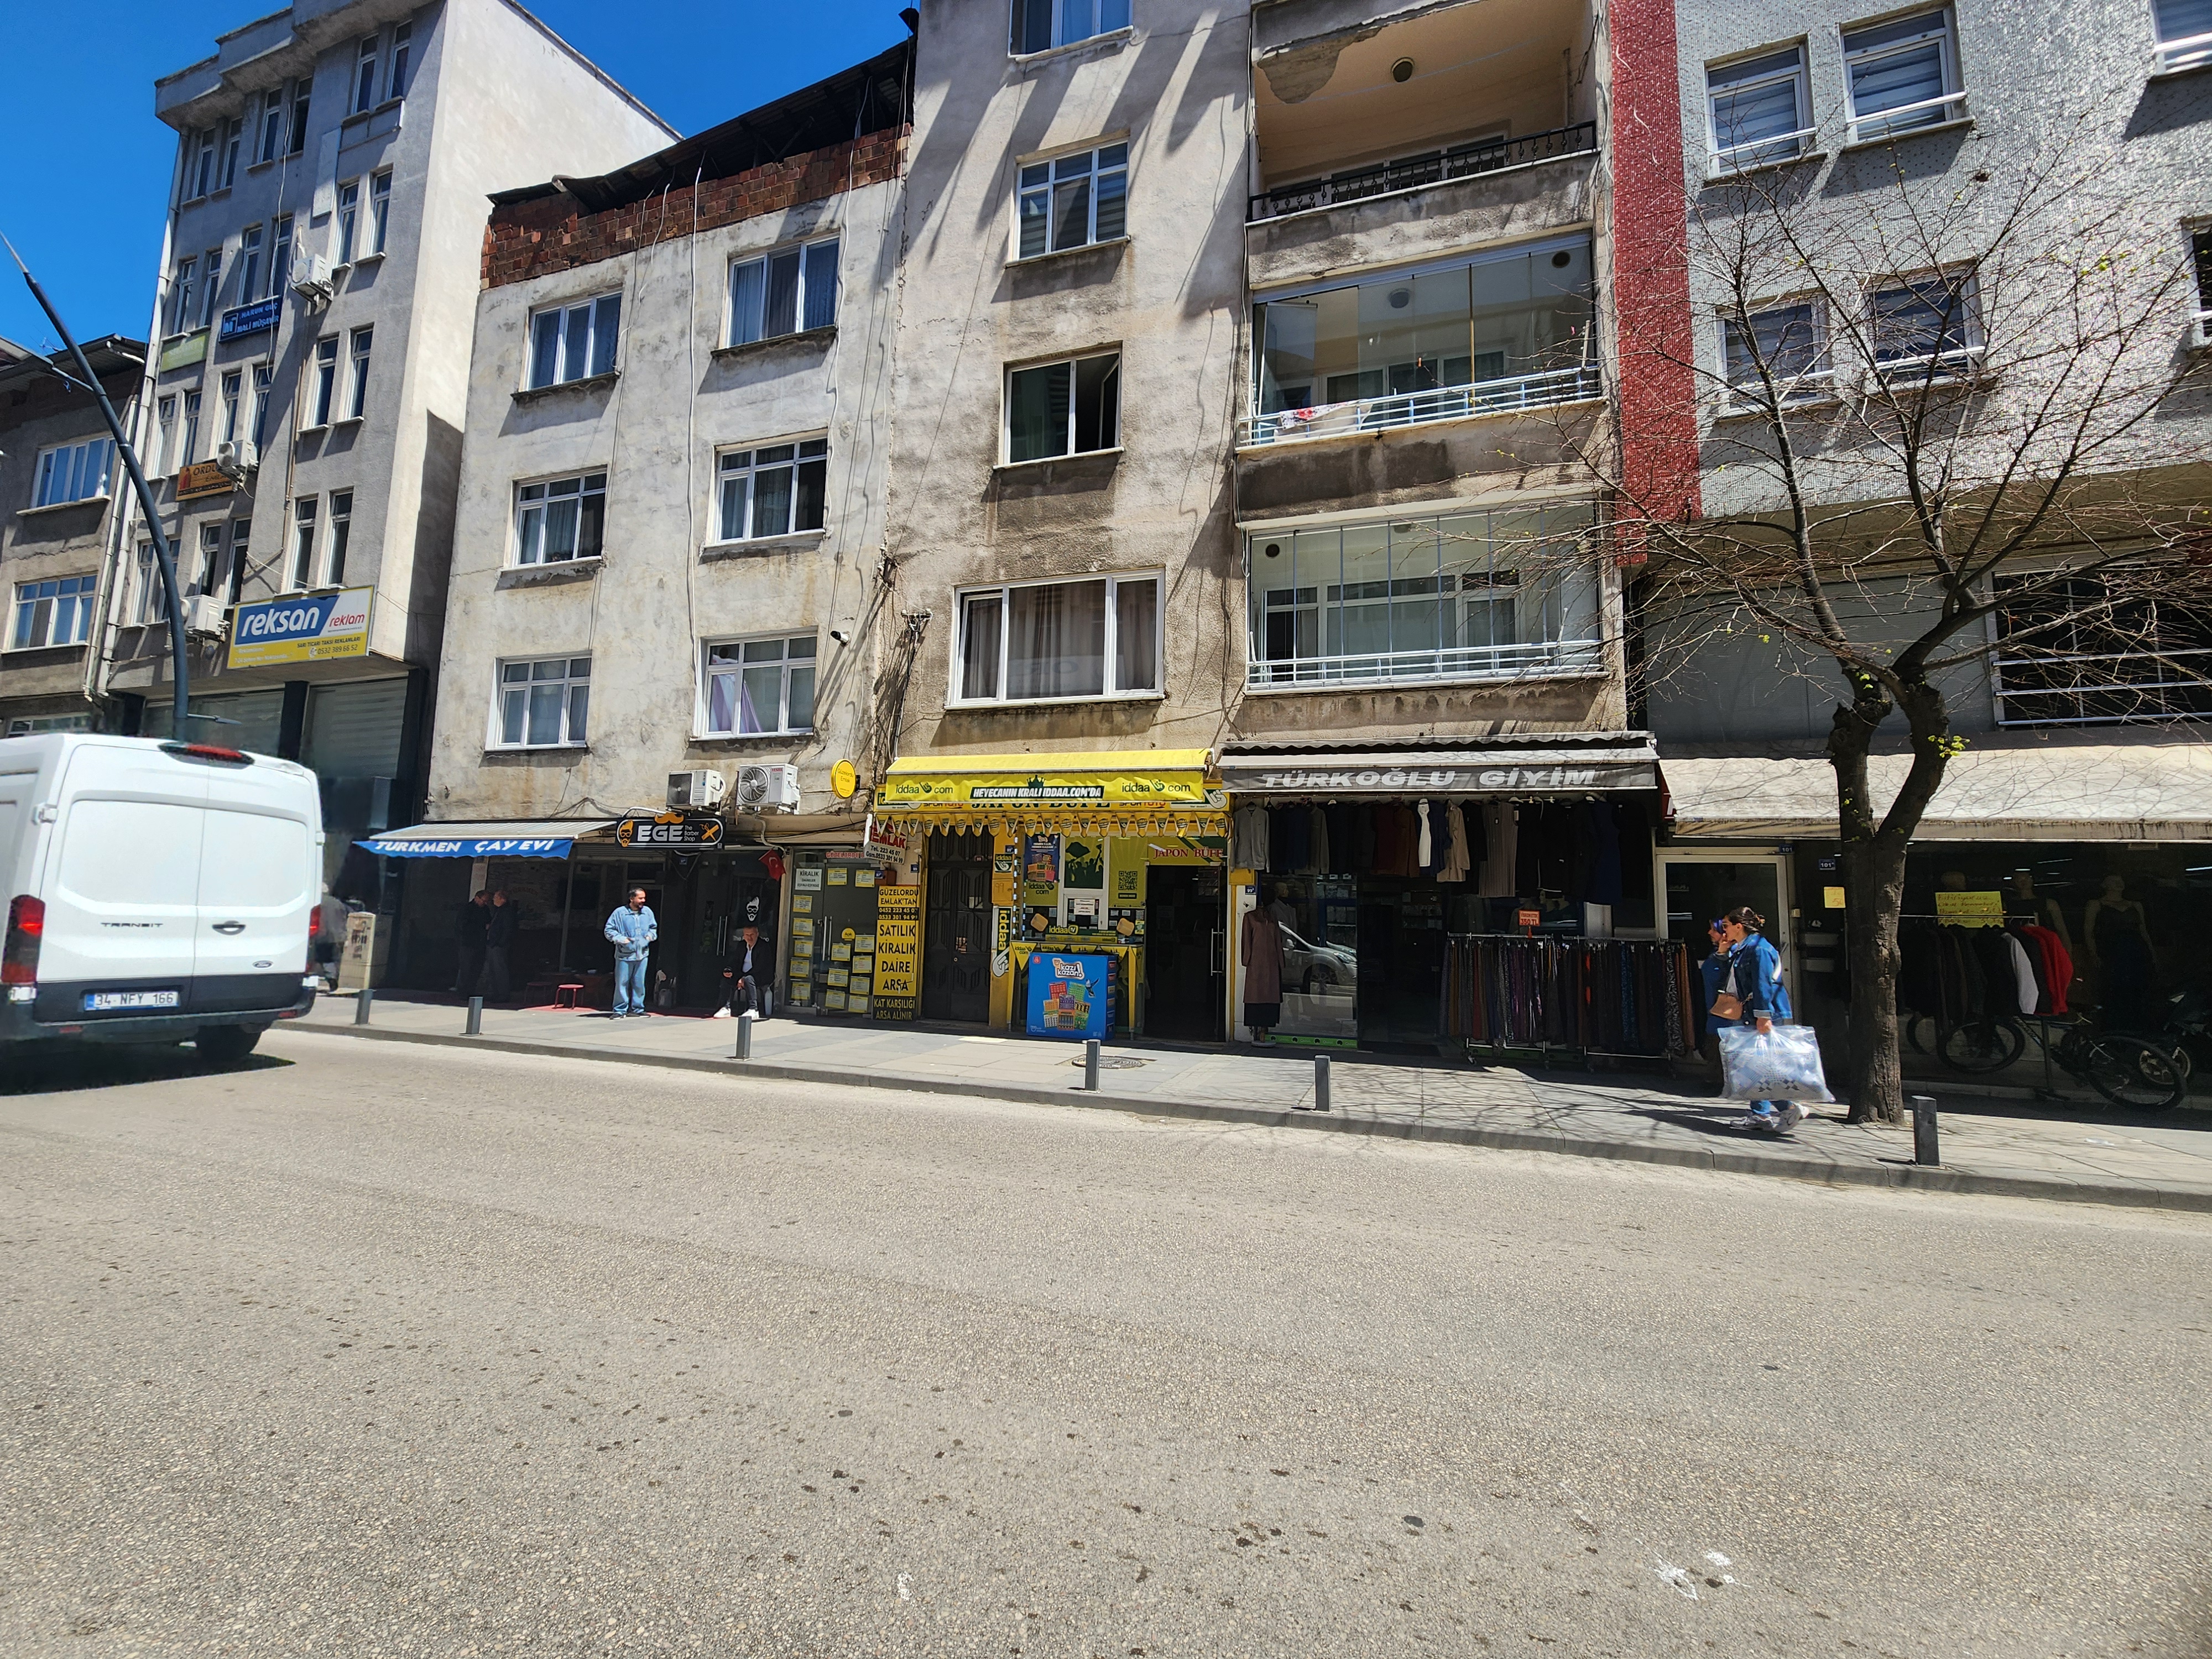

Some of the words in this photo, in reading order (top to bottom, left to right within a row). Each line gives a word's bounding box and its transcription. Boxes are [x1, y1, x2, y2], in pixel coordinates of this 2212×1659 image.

[241, 607, 320, 637] reksan
[329, 614, 365, 627] reklam
[837, 768, 854, 778] Güzelordu
[1263, 768, 1456, 788] TÜRKOĞLU
[1479, 767, 1595, 786] GİYİM
[896, 784, 920, 794] iddaa
[973, 788, 1018, 797] HEYECANIN
[1018, 787, 1042, 797] KRALI
[1042, 786, 1102, 797] IDDAA.COM'DA
[1121, 782, 1150, 792] iddaa
[637, 825, 684, 842] EGE
[871, 828, 907, 849] EMLAK
[474, 840, 515, 853] ÇAY
[518, 839, 555, 851] EVİ
[1154, 848, 1189, 859] JAPON
[879, 887, 919, 896] GÜZELORDU
[879, 924, 916, 937] SATILIK
[998, 910, 1010, 951] iddaa
[1048, 925, 1068, 933] iddaa
[878, 939, 916, 954] KİRALIK
[881, 958, 911, 973] DAİRE
[882, 979, 909, 992] ARSA
[95, 994, 111, 1006] 34
[120, 993, 144, 1004] NFY
[153, 993, 174, 1004] 166
[874, 998, 886, 1008] KAT
[886, 997, 915, 1010] KARŞILIĞI
[875, 1010, 891, 1020] ARSA
